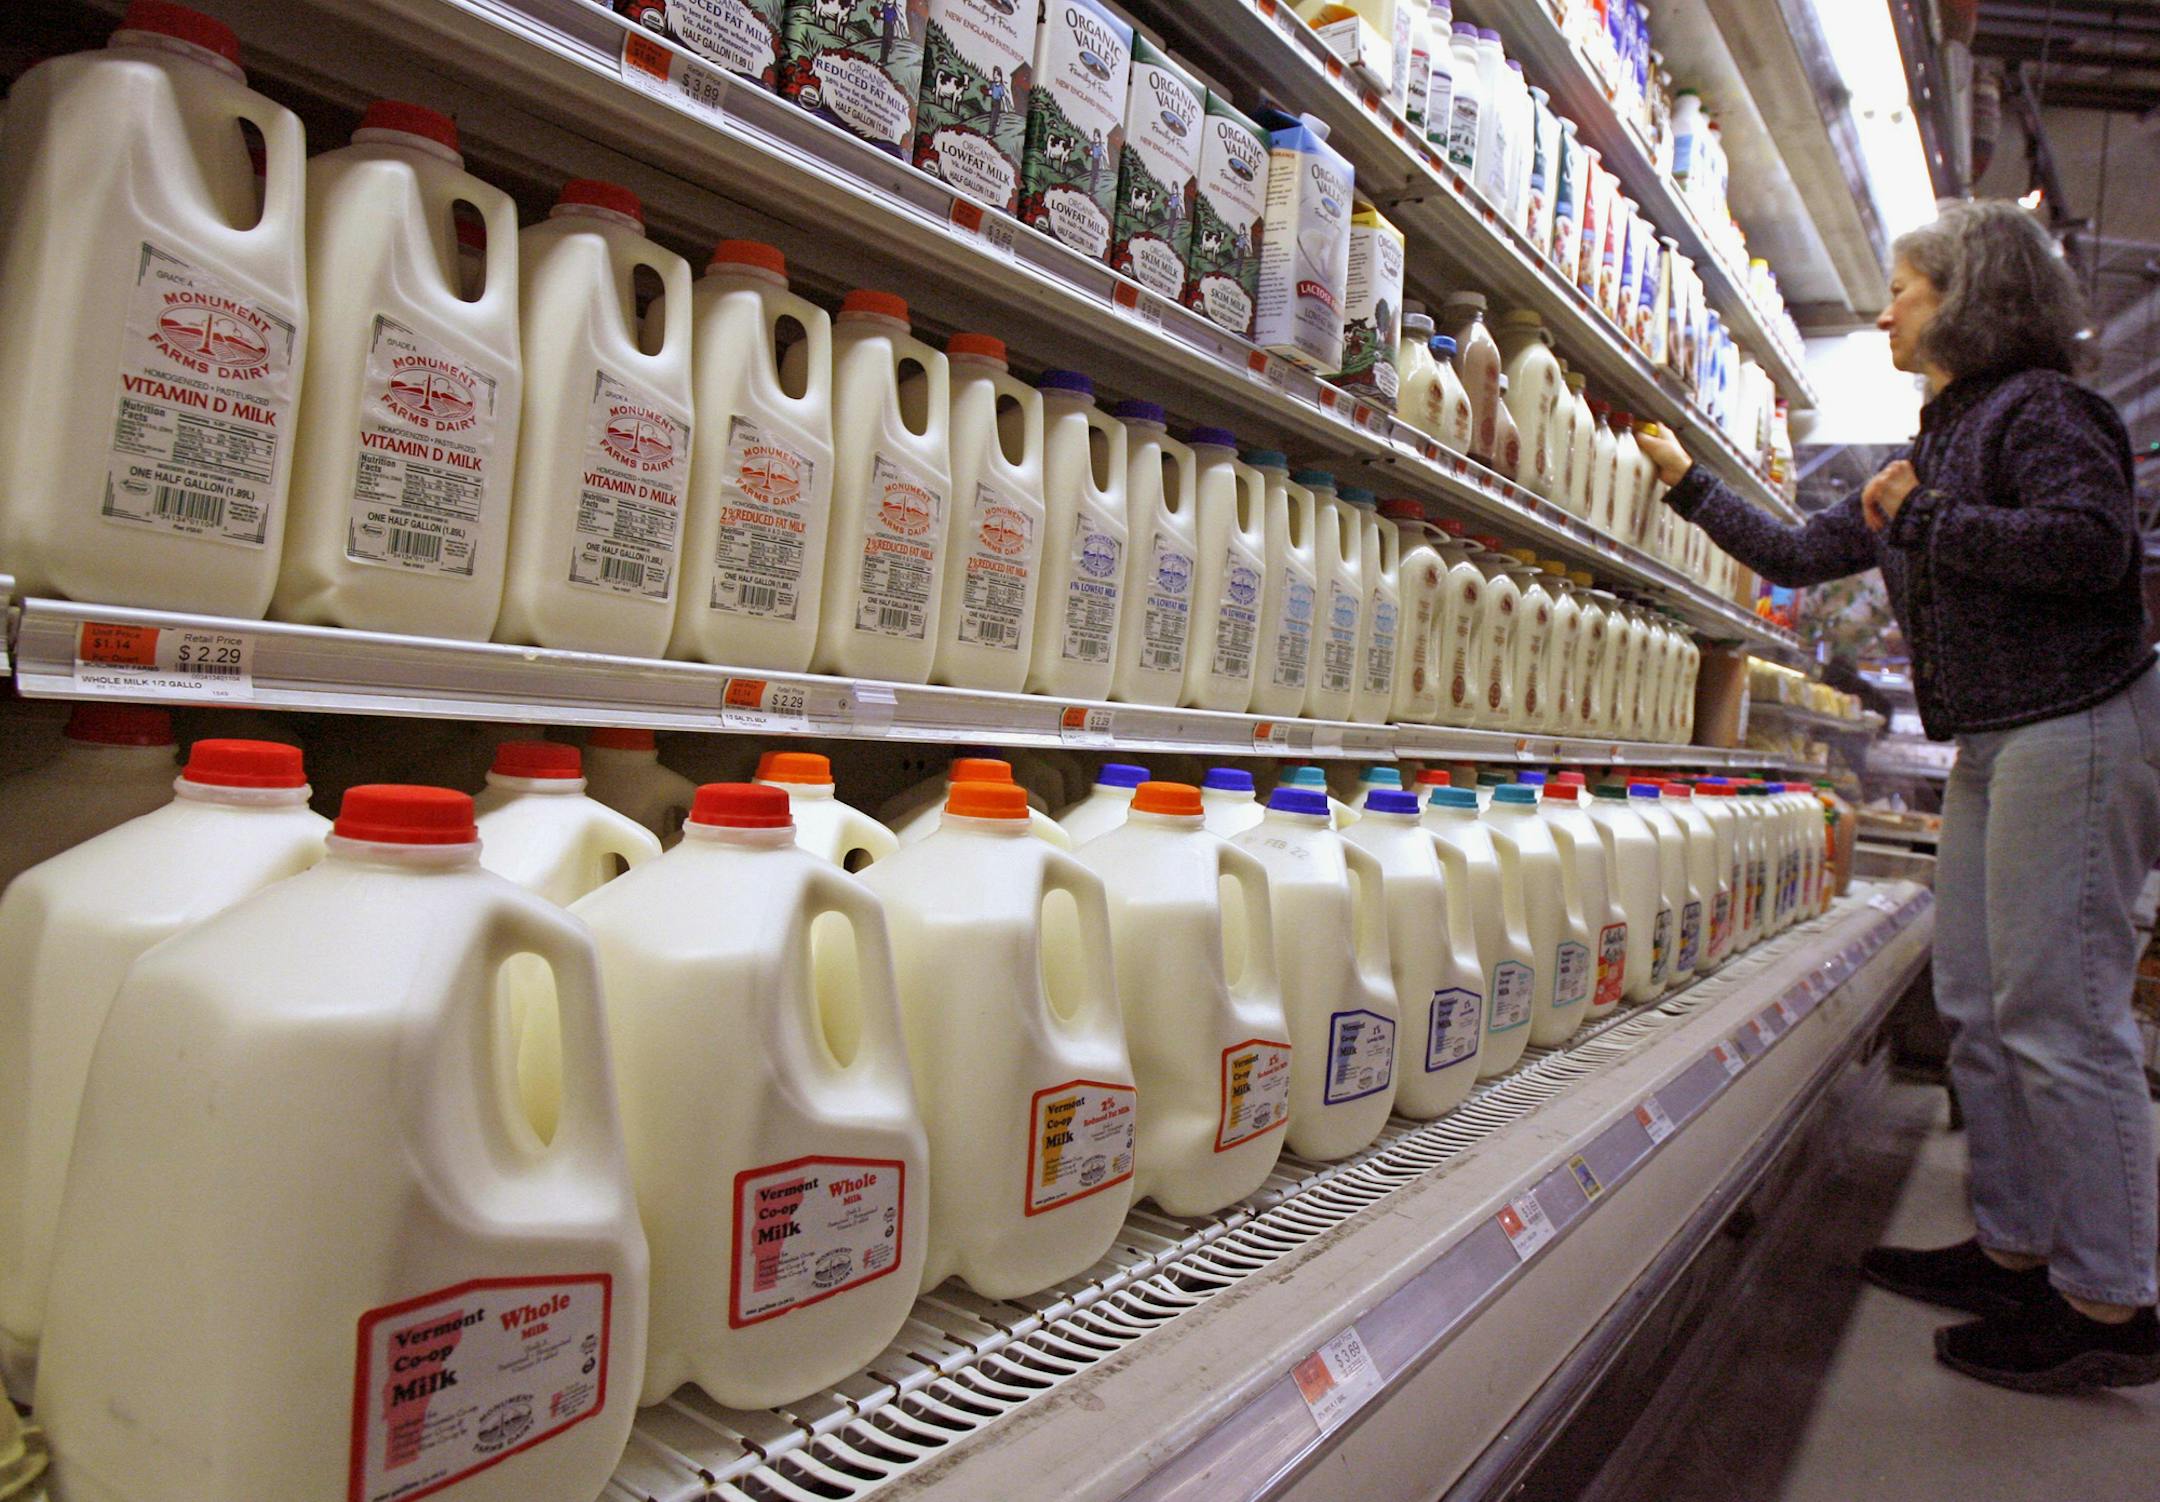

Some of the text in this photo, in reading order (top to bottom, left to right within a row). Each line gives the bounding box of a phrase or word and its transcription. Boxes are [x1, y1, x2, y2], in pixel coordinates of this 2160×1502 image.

[703, 15, 712, 24] fat
[714, 21, 728, 33] than
[725, 12, 772, 46] FAT MILK
[945, 9, 995, 43] NEW ENGLAND
[1066, 8, 1122, 62] ORGANIC
[682, 27, 701, 43] HALF
[703, 37, 730, 59] GALLON
[1073, 29, 1117, 72] VALLEY
[682, 73, 719, 100] $ 3.89
[816, 59, 908, 116] REDUCED FAT MILK
[849, 62, 887, 90] ORGANIC
[1149, 71, 1198, 119] ORGANIC
[835, 101, 875, 128] HALF GALLON
[1156, 90, 1192, 129] VALLEY
[1217, 122, 1264, 163] ORGANIC
[942, 142, 1010, 186] LOWFAT MILK
[1224, 140, 1259, 173] VALLEY
[1052, 199, 1106, 237] LOWFAT MILK
[1141, 250, 1160, 268] SKIM
[156, 270, 186, 286] GRADE
[1301, 284, 1331, 304] LACTOSE
[163, 291, 271, 334] MONUMENT
[148, 332, 270, 381] FARMS DAIRY
[392, 356, 477, 388] MONUMENT
[144, 368, 270, 406] HOMOGENIZED PASTEURIZED
[122, 374, 276, 428] VITAMIN D MILK
[123, 400, 165, 417] Nutrition
[381, 393, 477, 431] FARMS DAIRY
[122, 409, 148, 422] Facts
[609, 405, 676, 434] MONUMENT
[361, 431, 483, 471] VITAMIN D MILK
[377, 425, 476, 454] HOMOGENIZED PASTEURIZED
[360, 462, 382, 473] Facts
[361, 454, 396, 468] Nutrition
[600, 439, 676, 473] FARMS DAIRY
[743, 447, 800, 469] MONUMENT
[129, 465, 255, 501] ONE HALF GALLON (1.89L)
[583, 472, 678, 507] VITAMIN D MILK
[735, 478, 800, 506] FARMS DAIRY
[884, 482, 931, 504] MONUMENT
[368, 512, 386, 523] ONE
[388, 515, 408, 527] HALF
[411, 520, 441, 532] GALLON
[721, 506, 806, 533] 2% REDUCED FAT MILK
[877, 511, 930, 537] FARMS DAIRY
[586, 542, 644, 562] ONE HALF GALLON
[878, 539, 909, 555] REDUCED
[909, 545, 920, 556] FAT
[724, 571, 776, 588] ONE HALF GALLON
[978, 559, 1005, 573] REDUCED
[1070, 581, 1117, 599] 1% LOWFAT MILK
[93, 639, 131, 650] $1.14
[184, 633, 243, 646] Retail Price
[178, 644, 241, 664] $ 2.29
[82, 675, 202, 689] WHOLE MILK 1/2 GALLO
[772, 694, 803, 708] $ 2.29
[1233, 1082, 1252, 1097] Milk
[1047, 1097, 1085, 1115] Vermont
[1100, 1096, 1116, 1112] 2%
[1047, 1115, 1072, 1129] Co-op
[1045, 1130, 1074, 1150] Milk
[759, 1178, 819, 1202] Vermont
[828, 1172, 877, 1198] Whole
[758, 1202, 799, 1220] Co-op
[843, 1193, 862, 1206] Milk
[757, 1222, 801, 1245] Milk
[500, 1293, 571, 1332] Whole
[395, 1308, 485, 1347] Vermont
[521, 1322, 550, 1341] Milk
[394, 1345, 455, 1373] Co-op
[1335, 1341, 1361, 1368] $ 3.69
[391, 1367, 458, 1408] Milk
